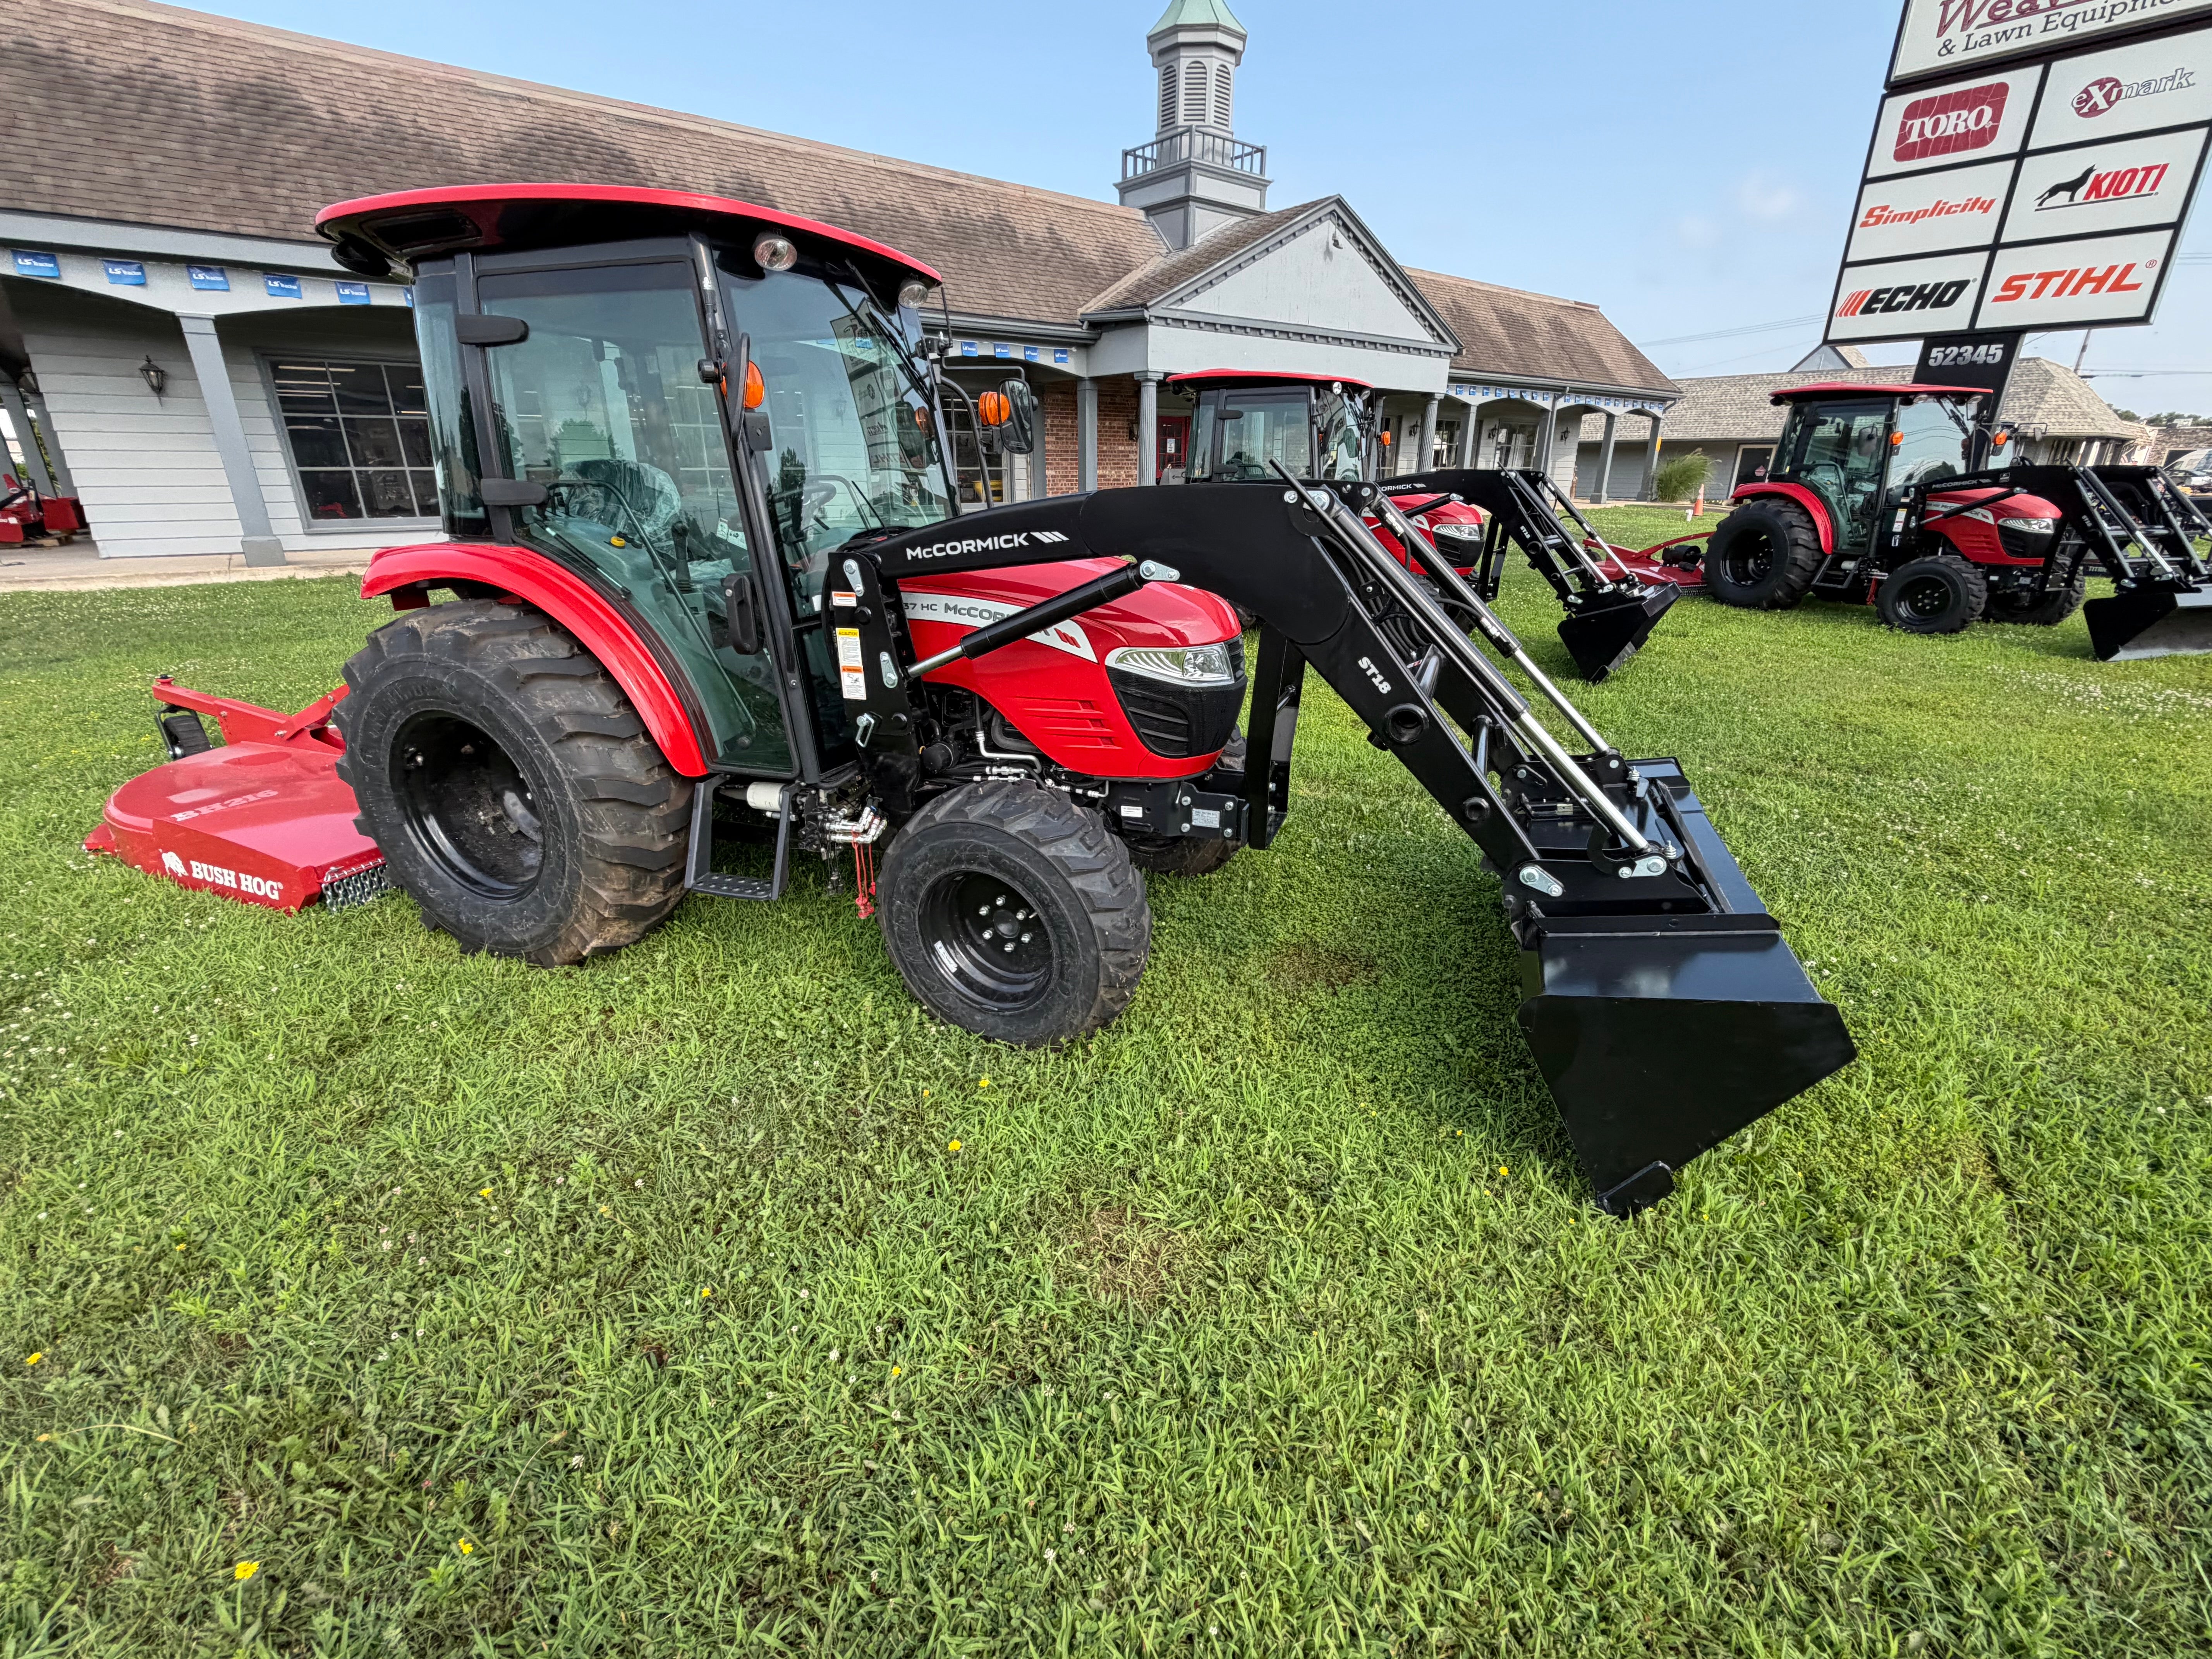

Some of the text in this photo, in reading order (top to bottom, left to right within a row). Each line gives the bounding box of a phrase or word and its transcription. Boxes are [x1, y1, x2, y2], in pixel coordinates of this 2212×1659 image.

[1937, 0, 2183, 57] & Lawn Equipm
[1906, 106, 1992, 143] TORO
[2083, 163, 2169, 201] KIOTI
[1860, 196, 1996, 228] Simplicity
[1859, 279, 1971, 315] ECHO
[1991, 263, 2143, 303] STIHL
[1928, 343, 2004, 367] 52345
[906, 532, 1029, 560] McCORMICK
[1358, 657, 1391, 694] ST18
[170, 789, 279, 821] BH216
[190, 860, 279, 900] BUSH HOG
